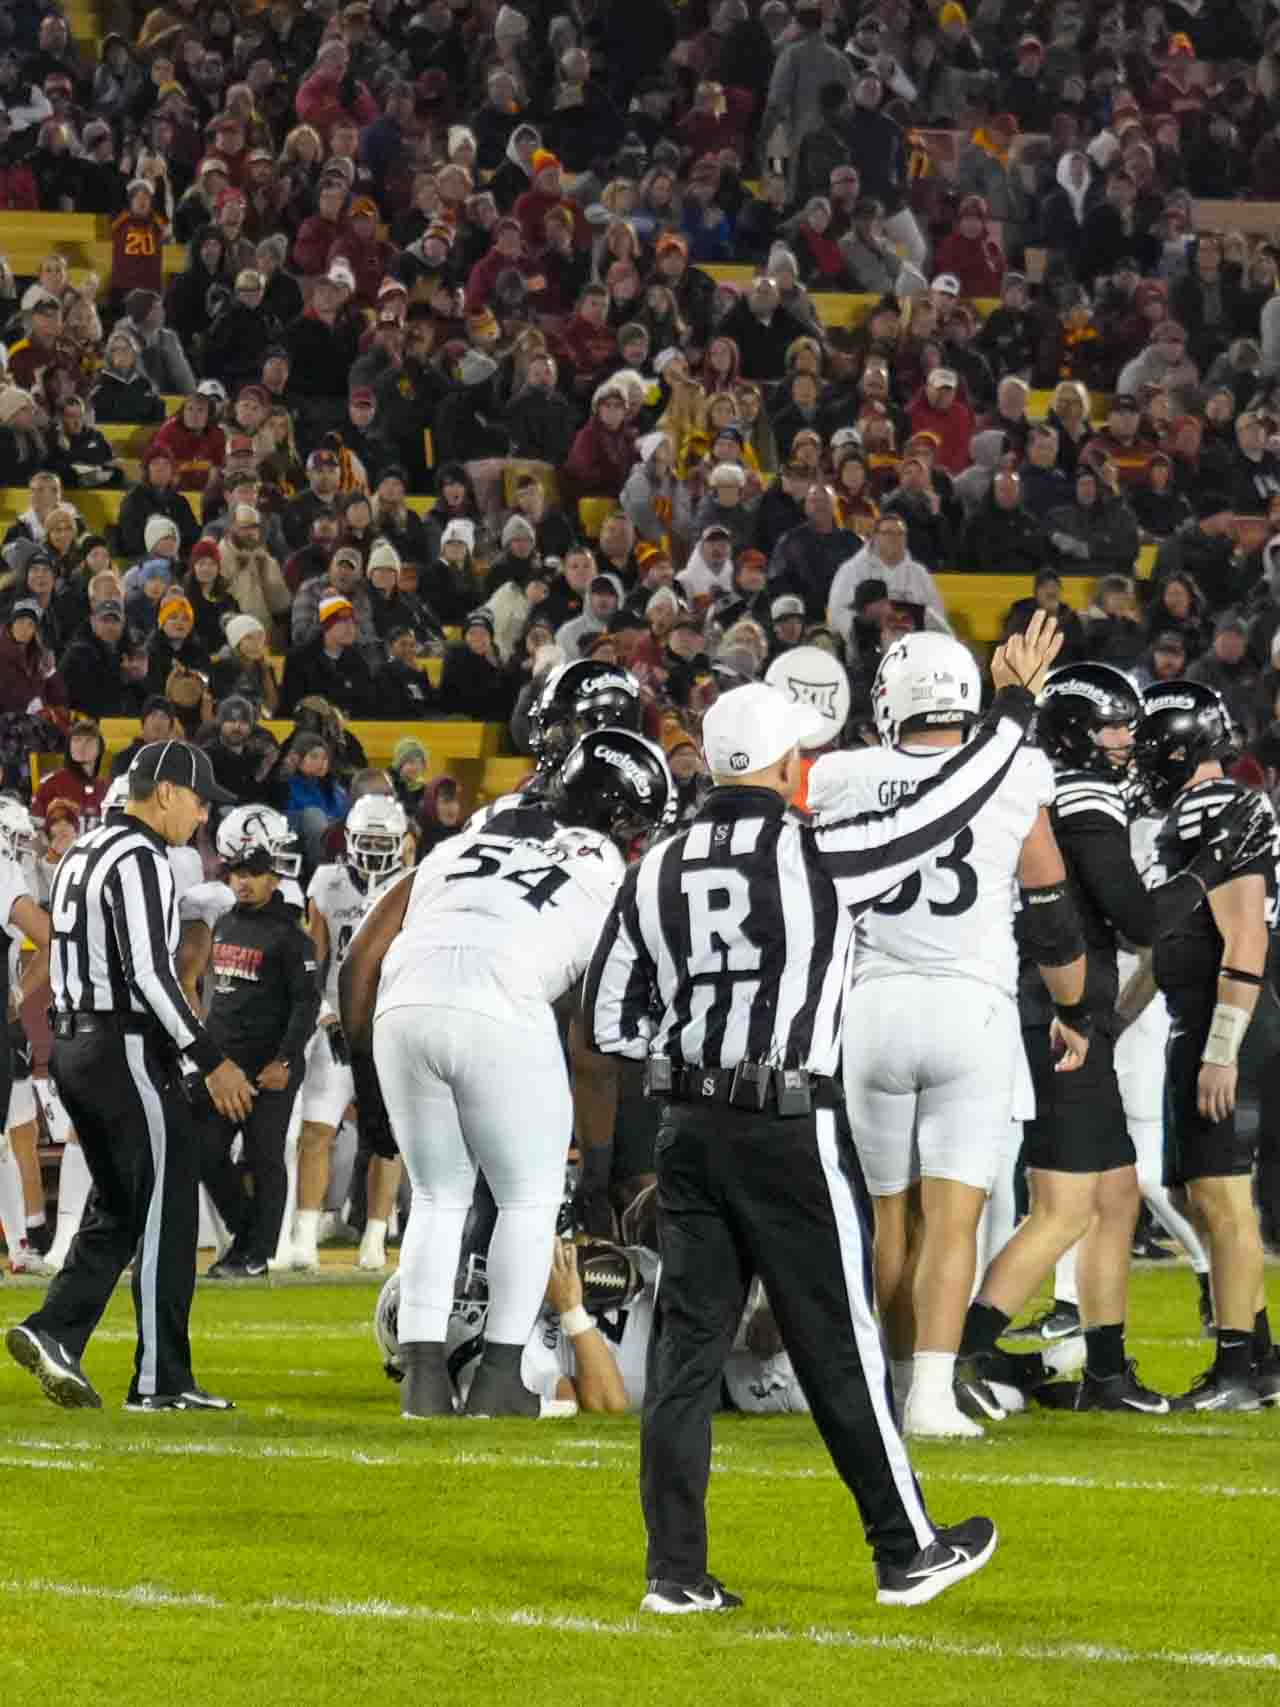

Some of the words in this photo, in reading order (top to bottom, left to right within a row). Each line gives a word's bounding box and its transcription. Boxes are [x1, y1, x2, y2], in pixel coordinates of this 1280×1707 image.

[126, 232, 155, 256] 20
[594, 744, 652, 804] Cyclones
[714, 824, 730, 842] S
[54, 853, 90, 933] C
[445, 843, 572, 913] 54
[680, 867, 763, 975] R
